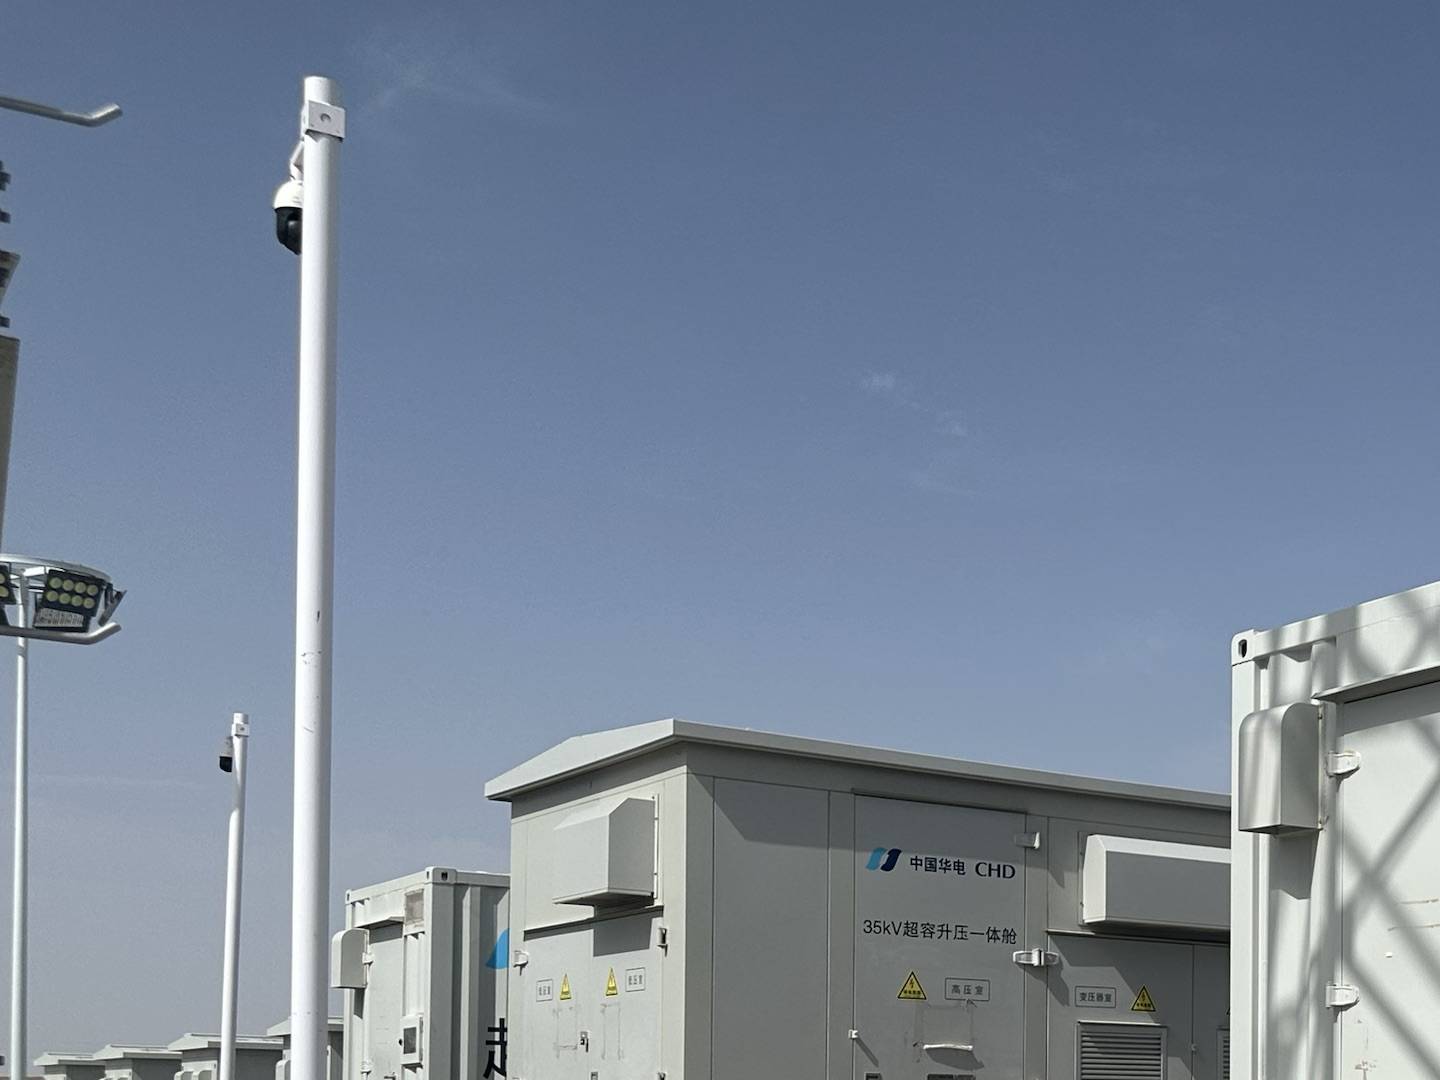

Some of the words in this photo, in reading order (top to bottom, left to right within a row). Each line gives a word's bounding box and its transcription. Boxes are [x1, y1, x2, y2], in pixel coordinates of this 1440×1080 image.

[910, 855, 966, 876] 中国华电
[975, 861, 1016, 879] CHD
[863, 919, 1017, 945] 35kV超容升压一体舱
